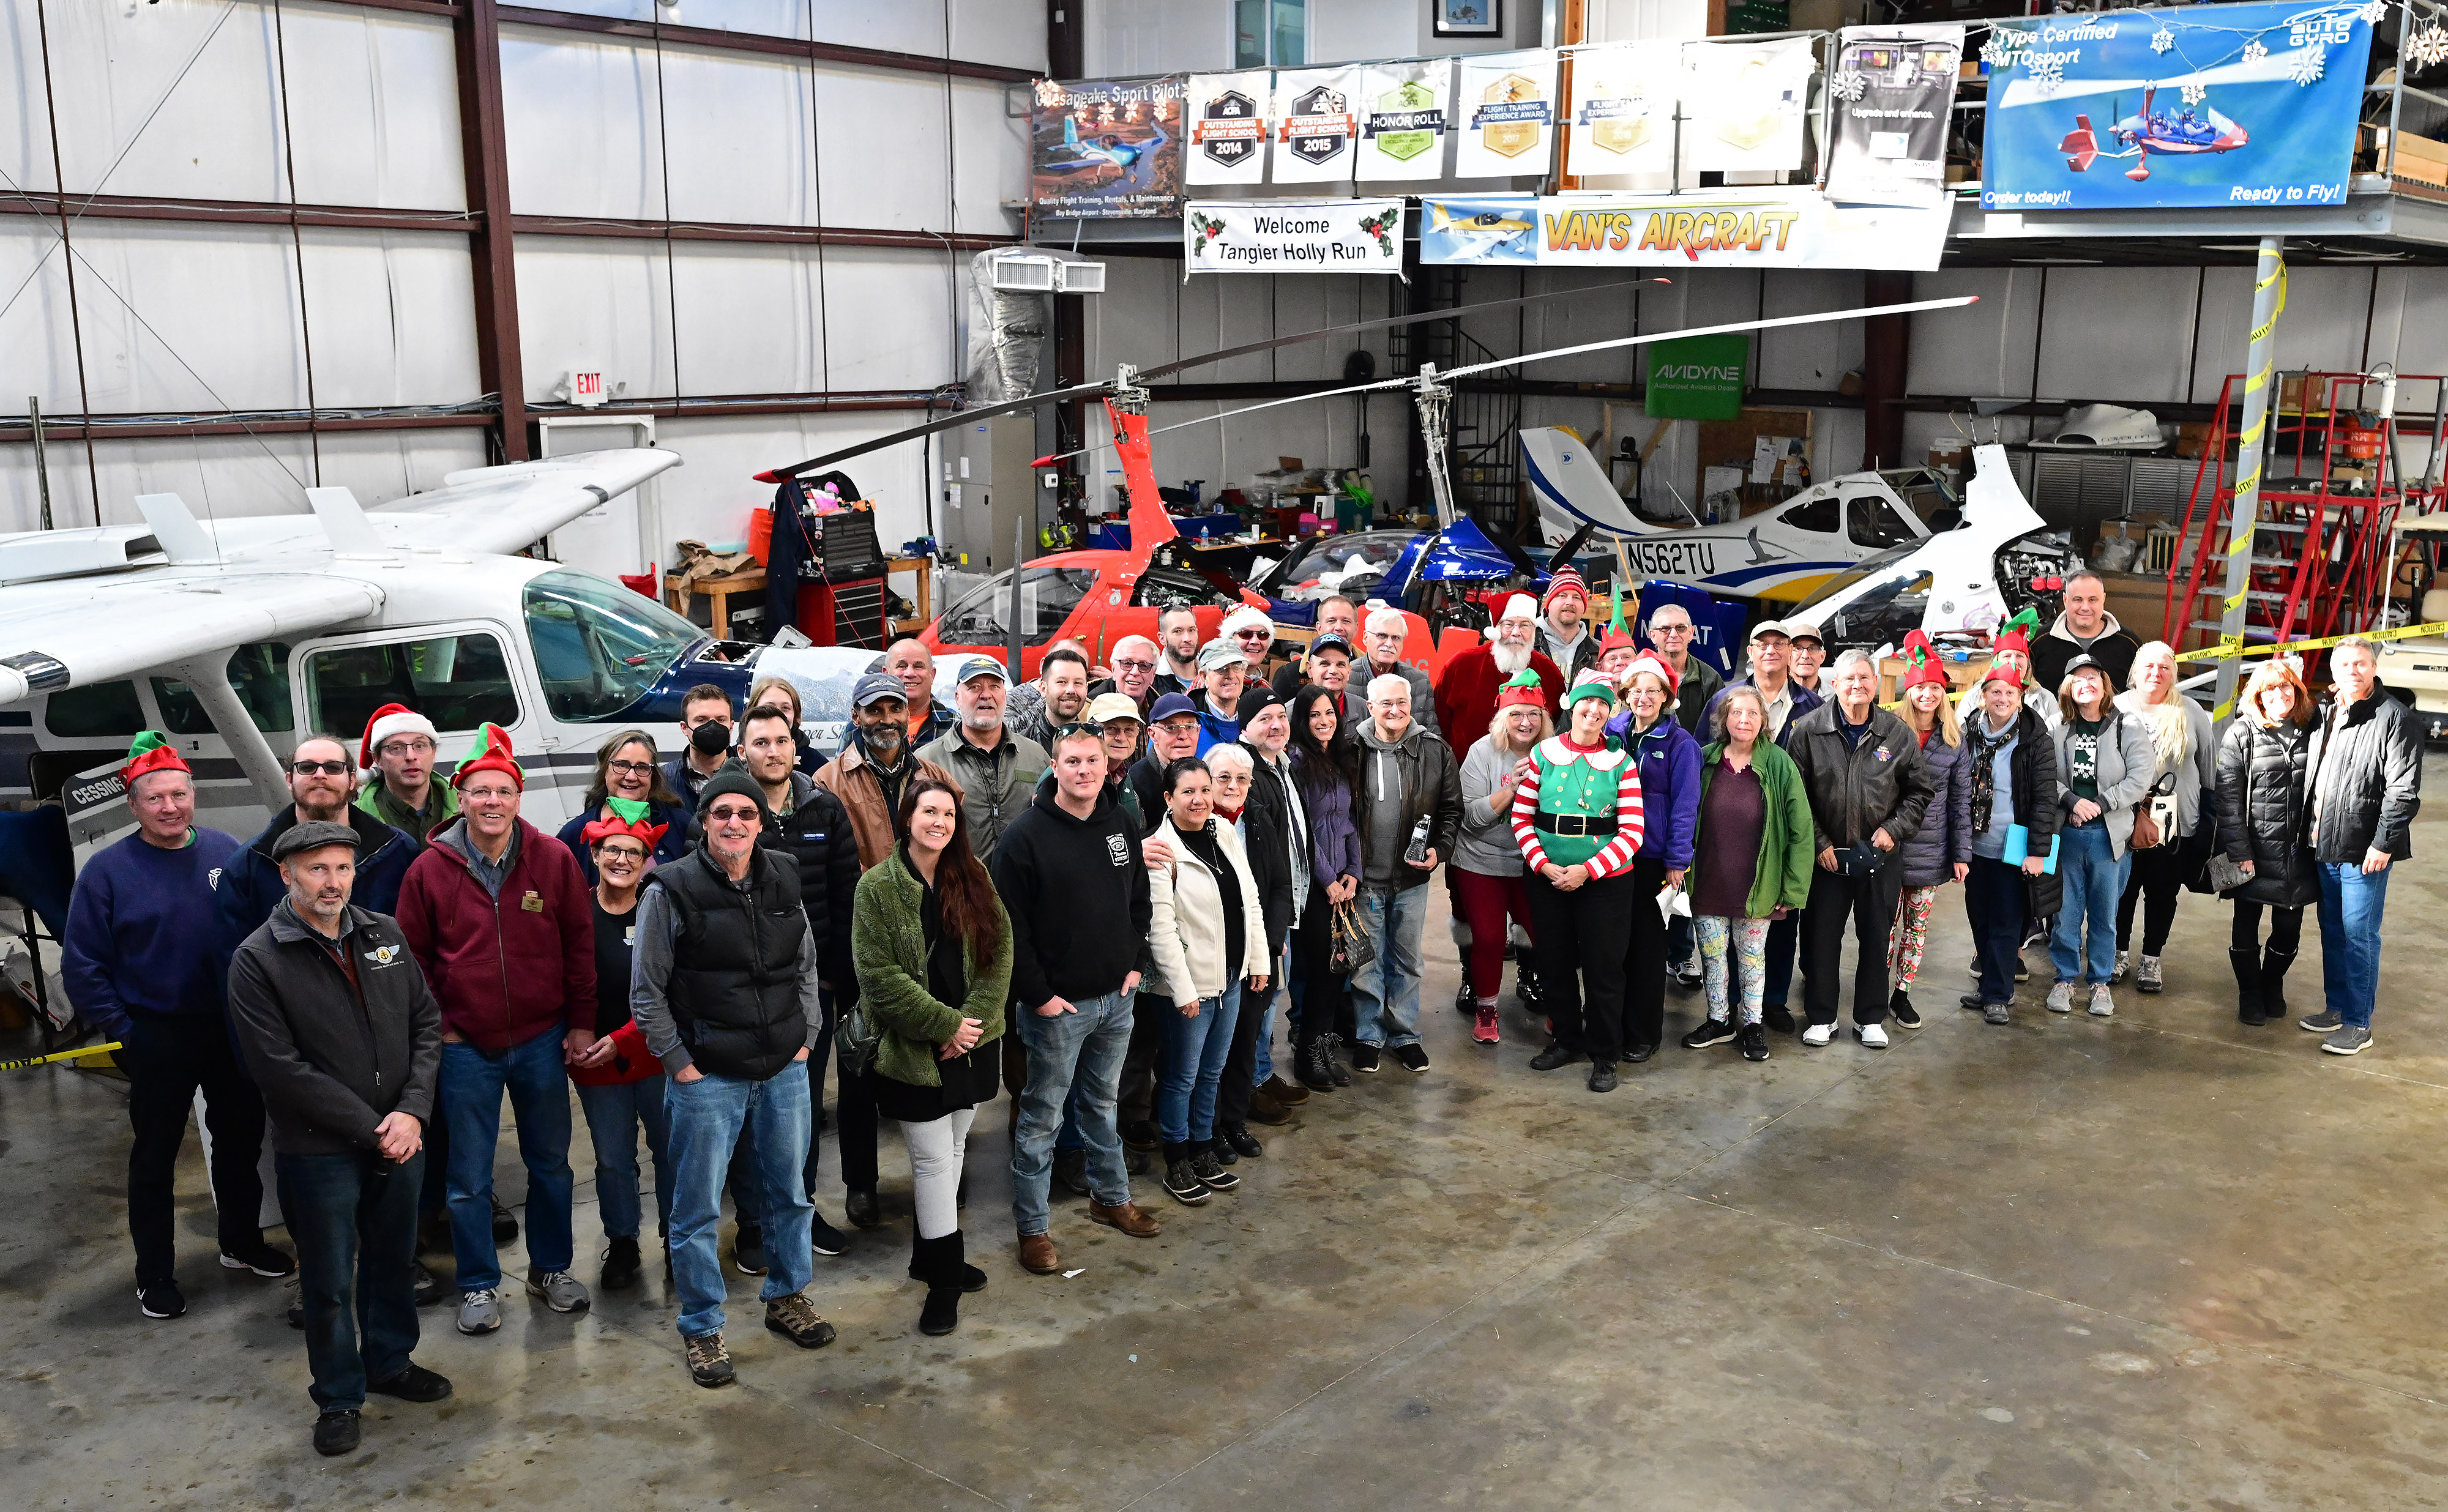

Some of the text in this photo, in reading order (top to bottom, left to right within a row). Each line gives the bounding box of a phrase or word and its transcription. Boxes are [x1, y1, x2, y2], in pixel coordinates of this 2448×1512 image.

[1997, 23, 2117, 49] Type Certified
[2289, 31, 2349, 45] GYRO
[1995, 48, 2080, 69] MTOsport
[1035, 82, 1180, 109] Cesapeake Sport Pilot
[1509, 103, 1540, 111] TRAINING
[1852, 108, 1934, 119] Upgrade and enhance.
[1372, 113, 1441, 128] HONOR ROLL
[1479, 112, 1519, 121] EXPERIENCE
[1204, 119, 1257, 129] OUTSTANDING
[1288, 124, 1349, 135] FLIGHT SCHOOL
[1201, 128, 1259, 138] FLIGHT SCHOOL
[1502, 135, 1520, 143] 2017
[1215, 141, 1243, 154] 2014
[1304, 138, 1332, 152] 2015
[1395, 144, 1412, 153] 2016
[1039, 196, 1059, 206] Quality
[1060, 196, 1077, 206] Flight
[1078, 196, 1103, 206] Training,
[1104, 195, 1129, 204] Rentals,
[1136, 194, 1175, 203] Maintenance
[1984, 190, 2071, 206] Order today!!
[2230, 184, 2340, 204] Ready to Fly!
[1254, 216, 1329, 234] Welcome
[1543, 210, 1799, 261] VAN'S AIRCRAFT
[1218, 242, 1367, 264] Tangier Holly Run
[1655, 364, 1739, 381] AVIDYNE
[577, 373, 600, 394] EXIT
[1627, 542, 1715, 575] N562TU
[2372, 630, 2397, 641] CAUTION
[2421, 623, 2445, 634] CAUTION
[2187, 650, 2212, 660] CAUTION
[72, 776, 125, 805] CESSNA
